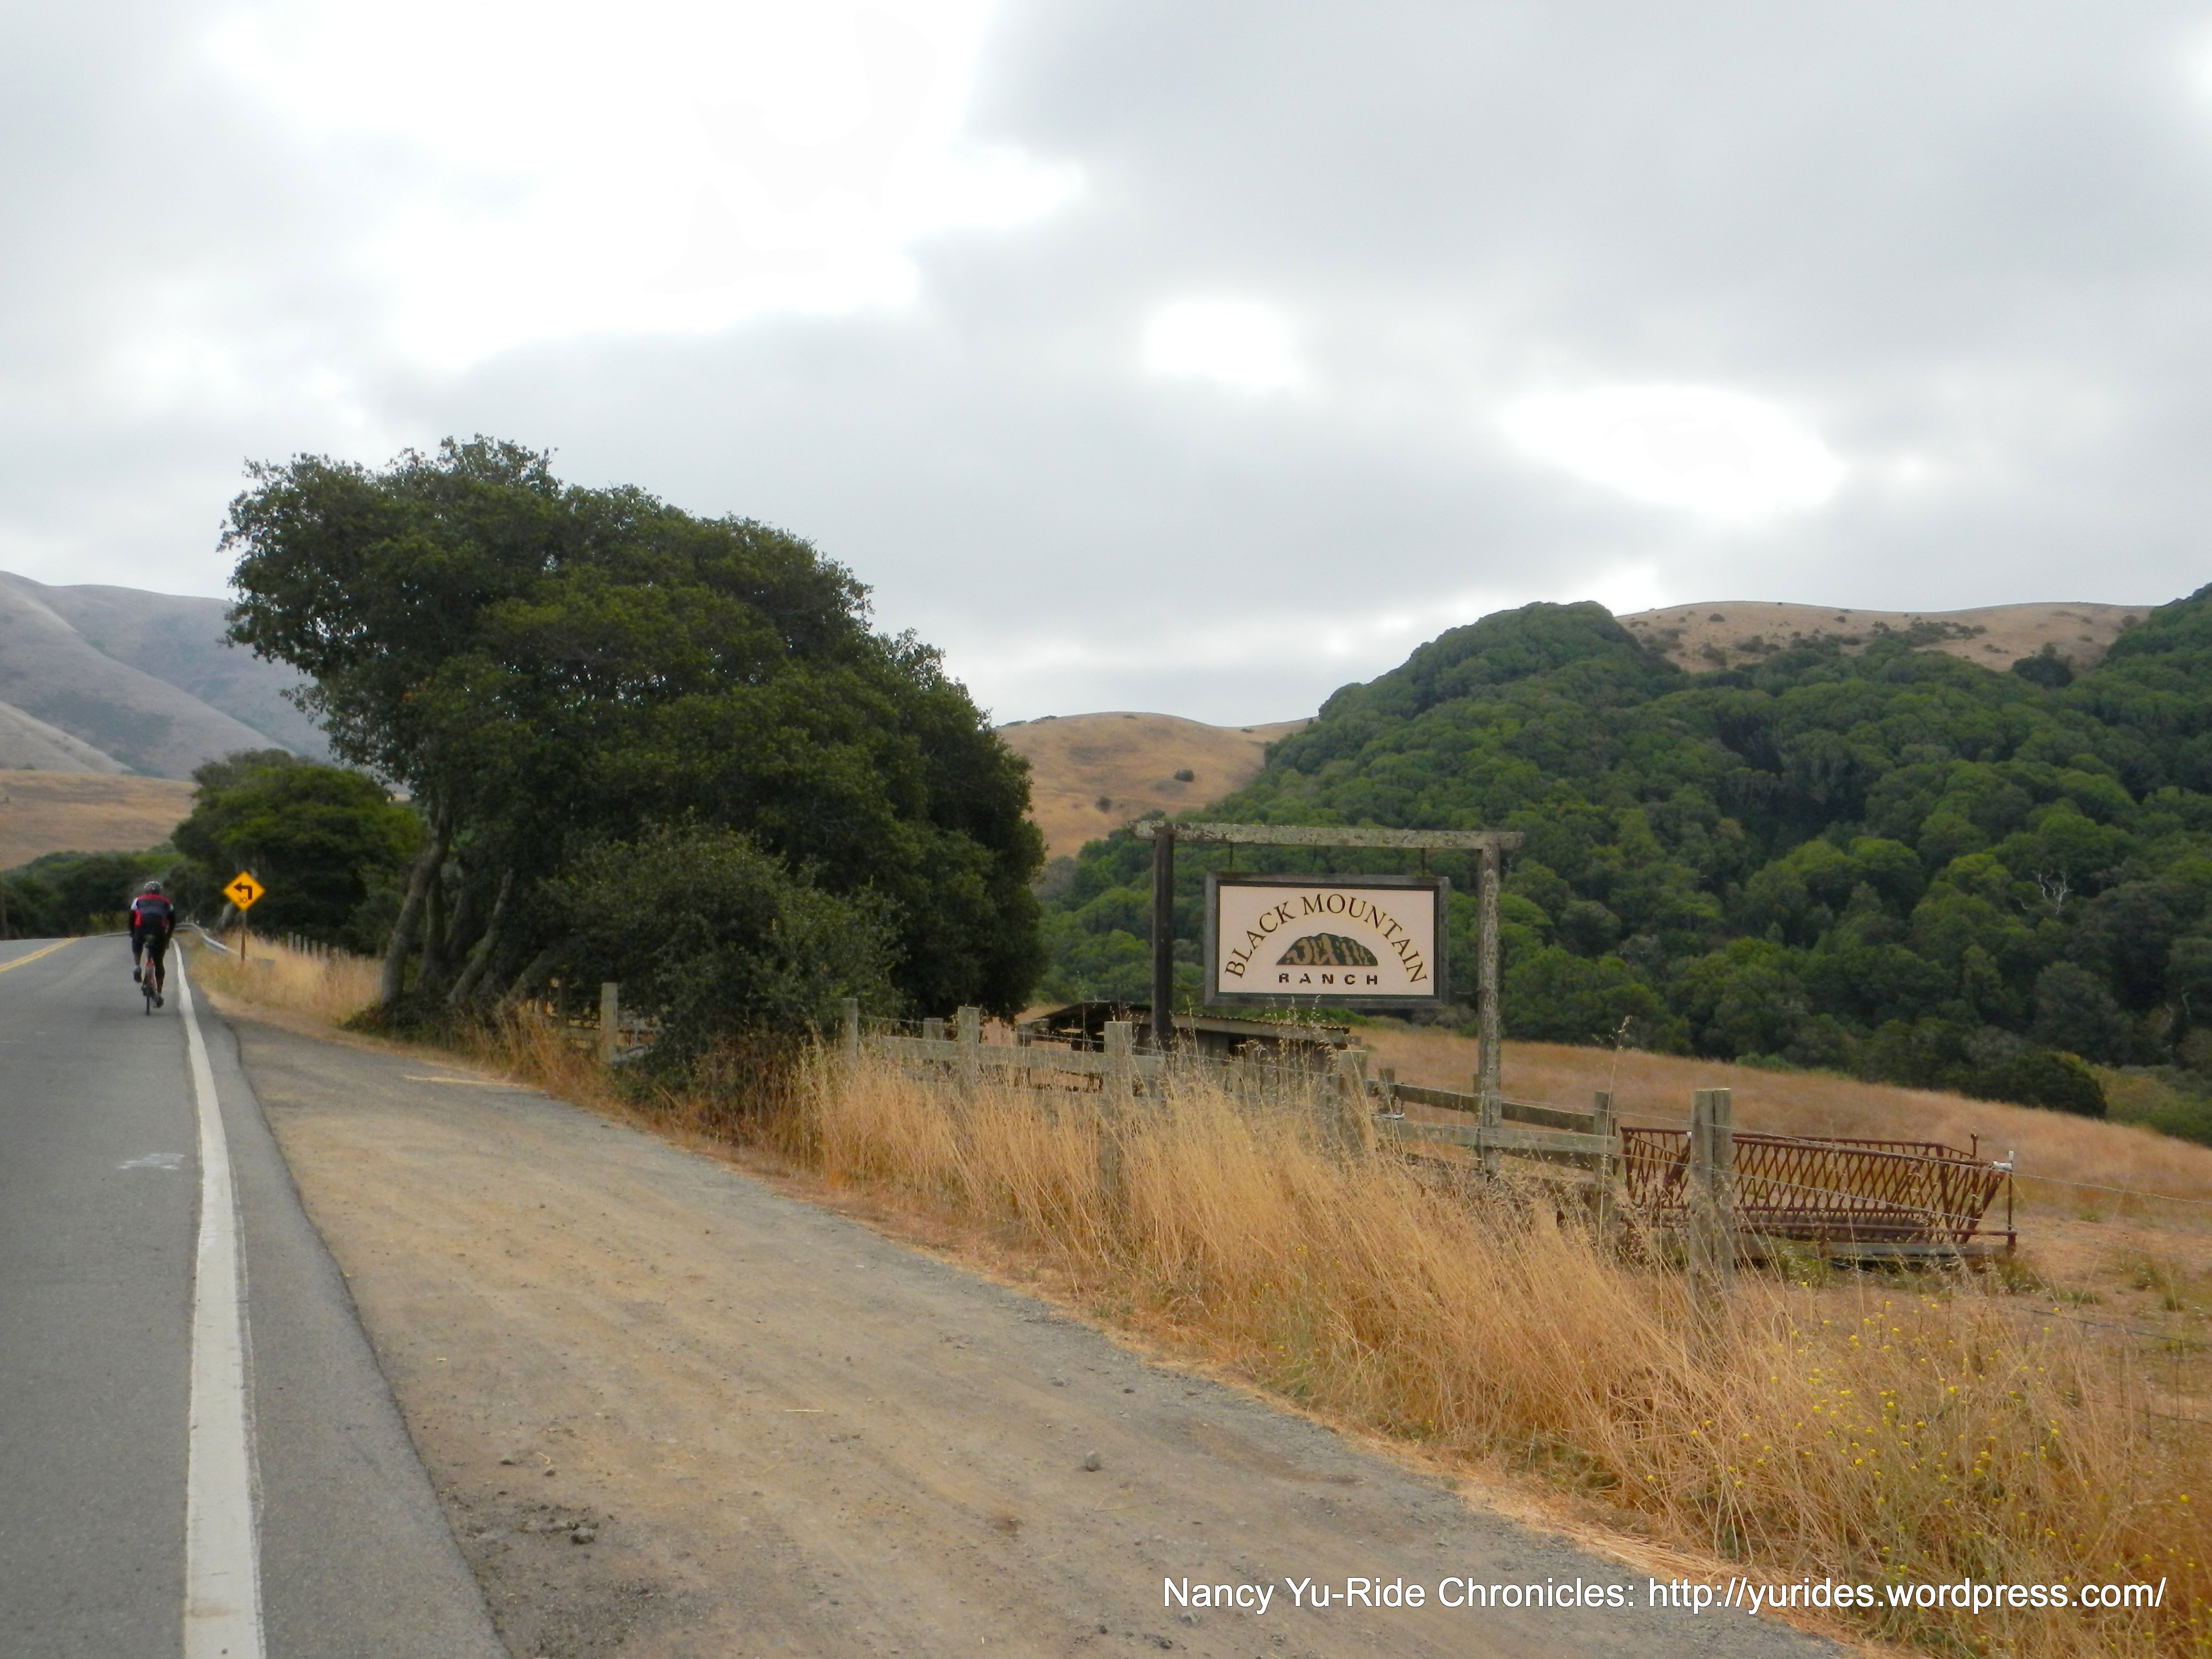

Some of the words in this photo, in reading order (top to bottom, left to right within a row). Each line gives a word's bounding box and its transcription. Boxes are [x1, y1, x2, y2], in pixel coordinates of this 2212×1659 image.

[1225, 902, 1296, 978] BLACK
[1300, 893, 1427, 983] MOUNTAIN
[1279, 973, 1378, 985] RANCH
